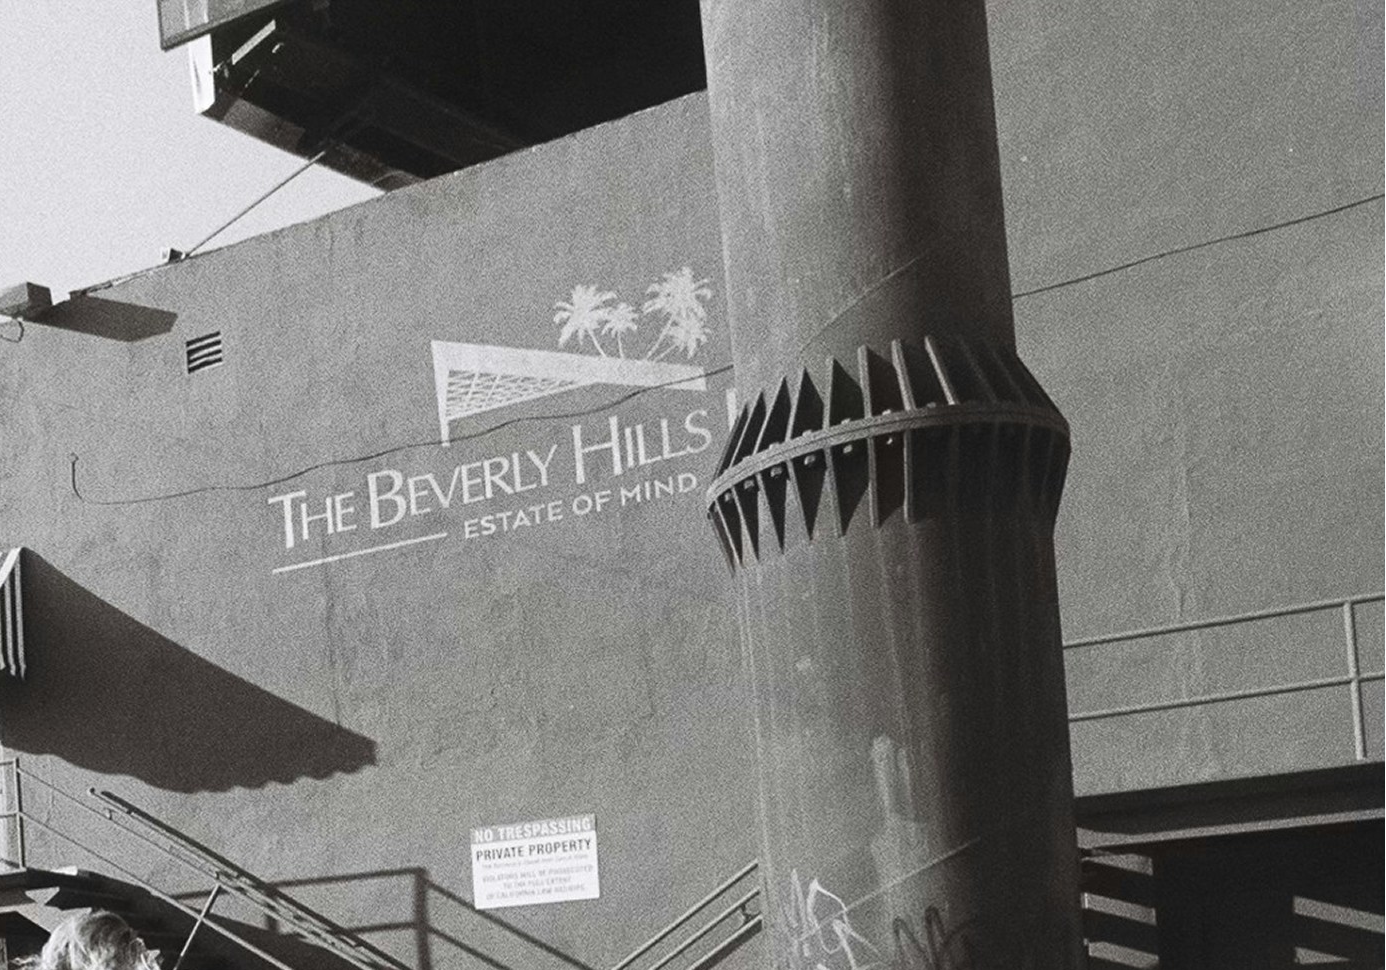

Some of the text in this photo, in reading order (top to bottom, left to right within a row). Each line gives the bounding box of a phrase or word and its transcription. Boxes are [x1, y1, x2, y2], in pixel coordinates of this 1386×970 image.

[464, 473, 698, 540] ESTATE OF MIND
[475, 817, 591, 843] NO TRESPASSING
[476, 846, 526, 861] PRIVATE
[528, 839, 592, 855] PROPERTY
